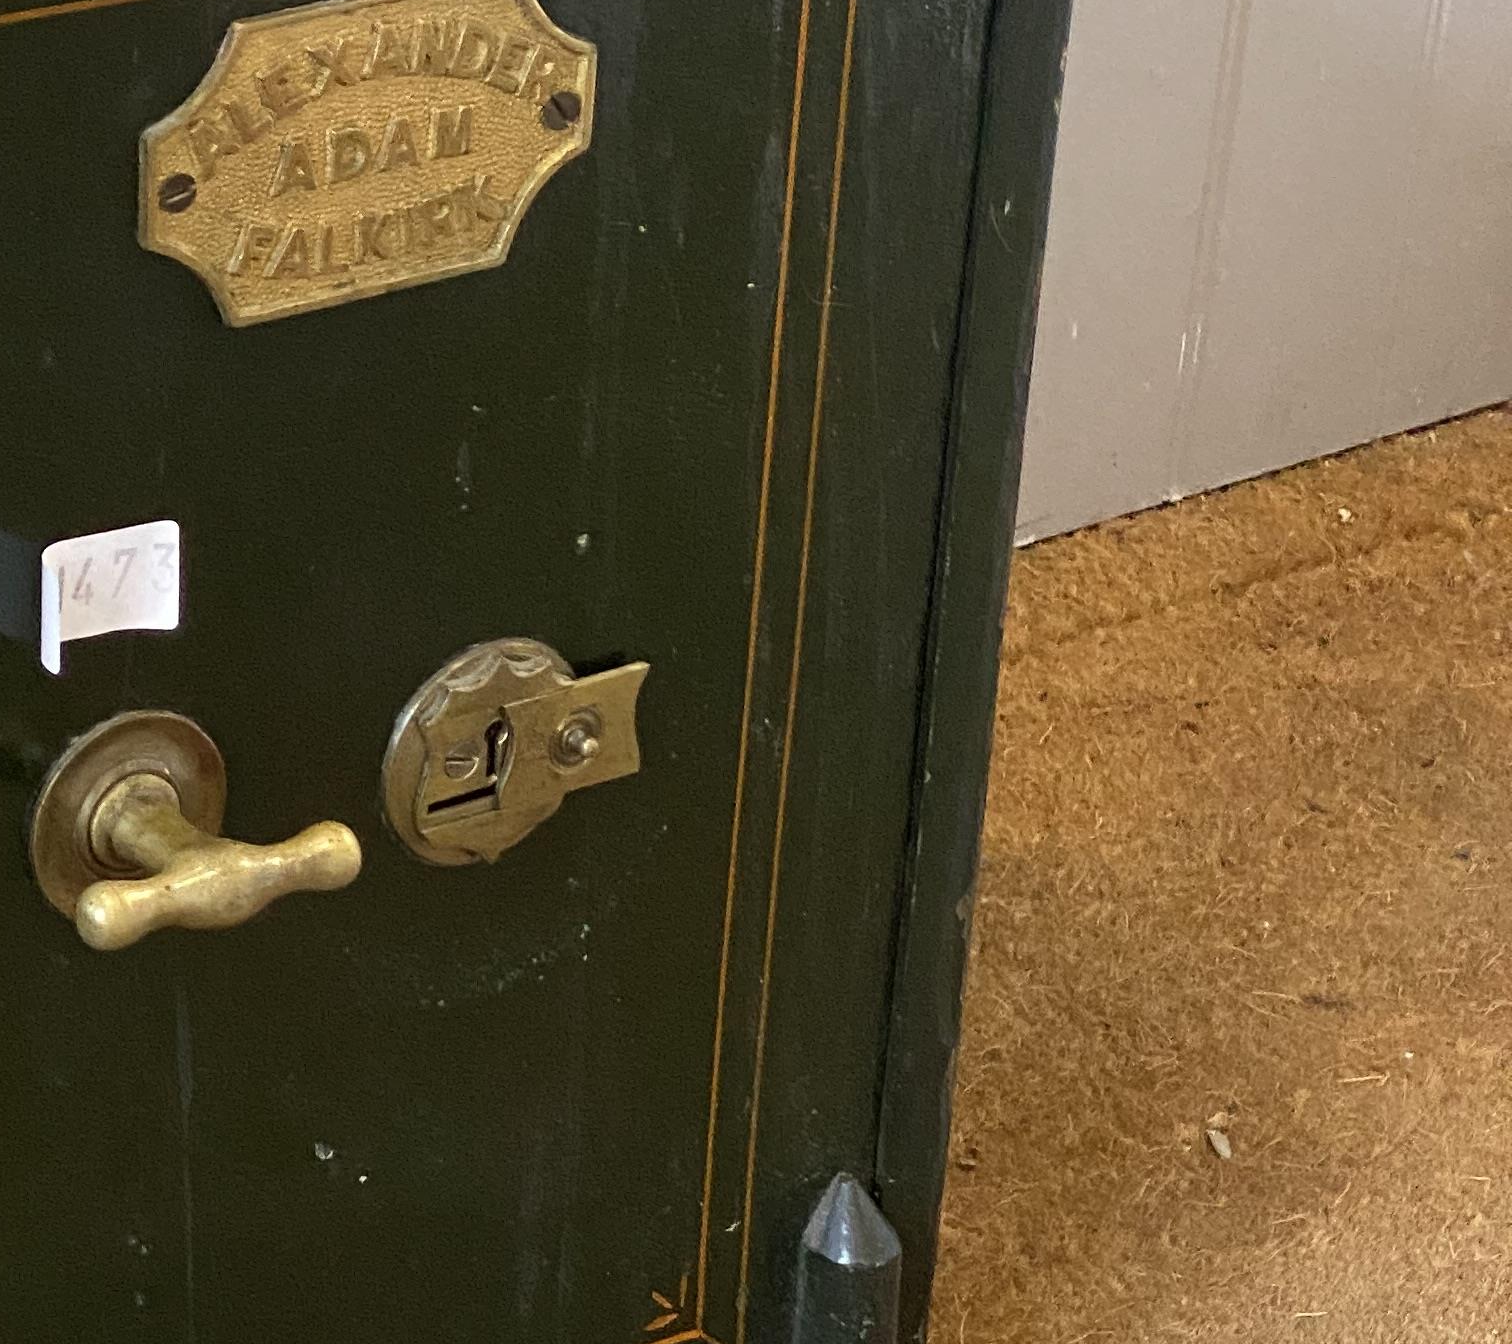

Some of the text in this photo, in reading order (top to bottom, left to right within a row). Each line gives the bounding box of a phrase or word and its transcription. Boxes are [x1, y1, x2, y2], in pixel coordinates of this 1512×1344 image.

[189, 18, 556, 182] ALEXANDER
[269, 105, 475, 197] ADAM
[228, 174, 505, 278] FALKIRK
